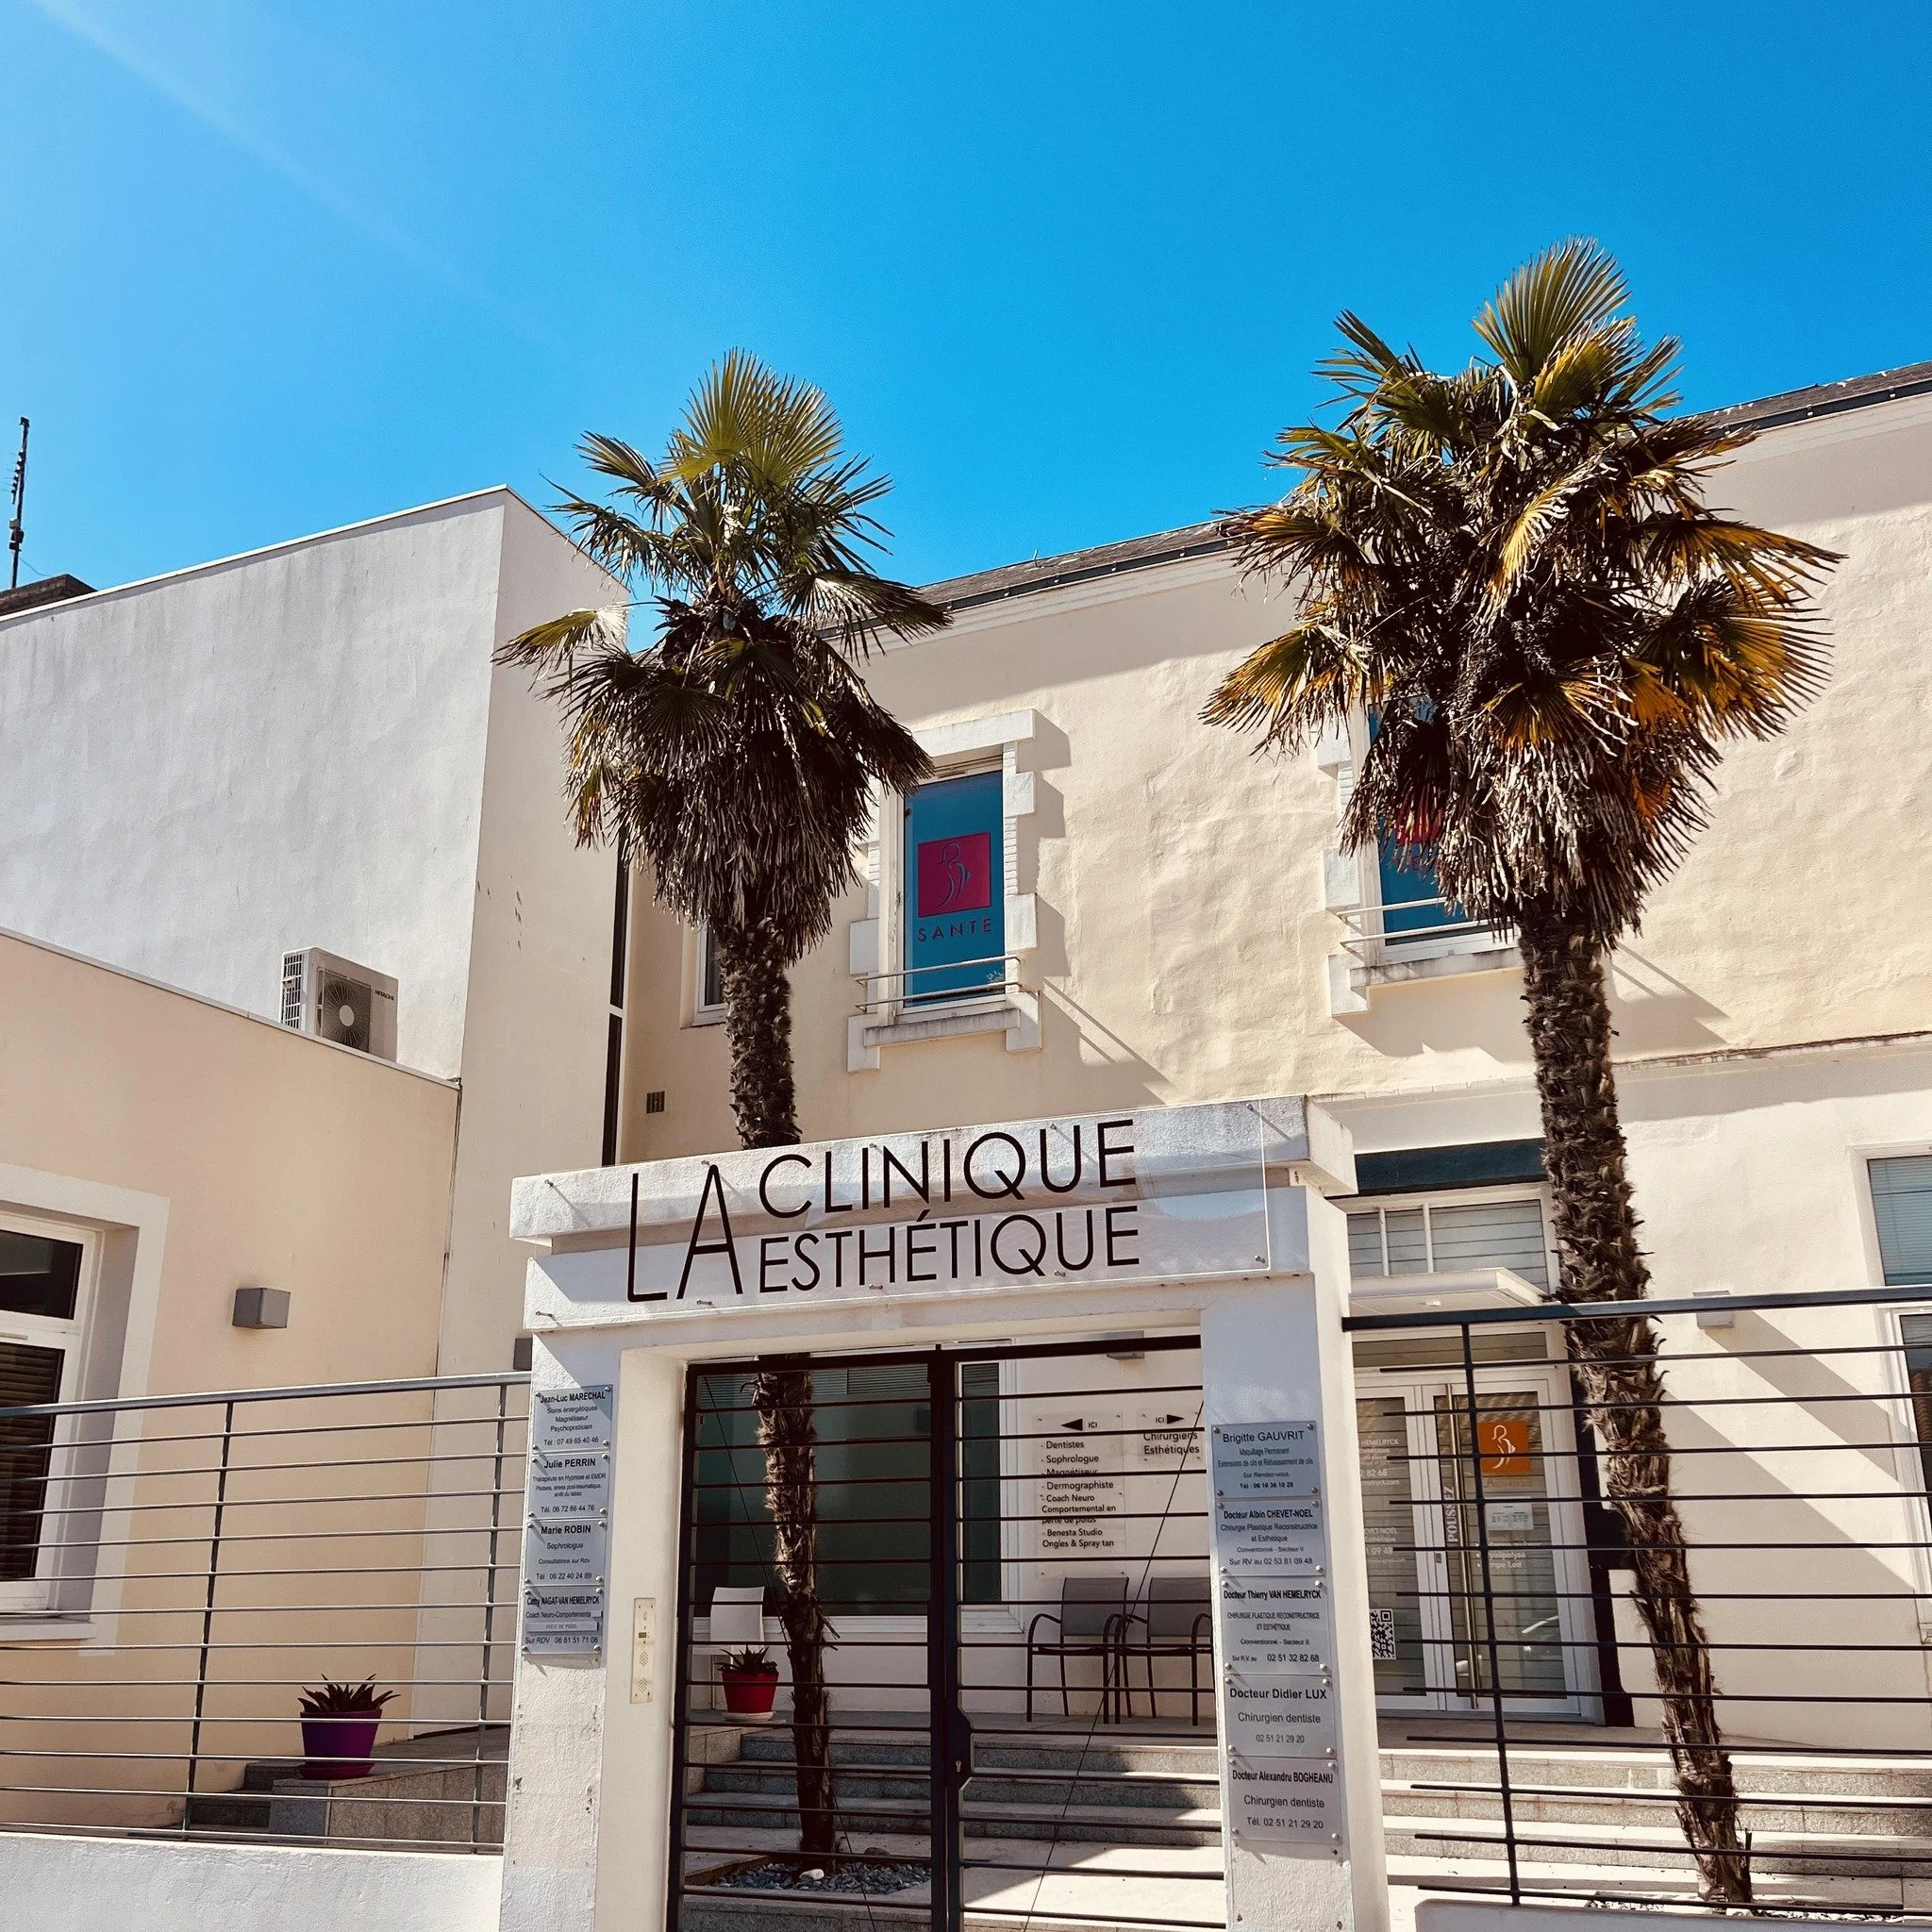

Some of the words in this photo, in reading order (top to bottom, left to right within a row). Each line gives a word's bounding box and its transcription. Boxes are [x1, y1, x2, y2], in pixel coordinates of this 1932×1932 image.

[626, 1164, 743, 1303] LA
[758, 1119, 1137, 1219] CLINIQUE
[758, 1205, 1140, 1293] ESTHÉTIQUE
[540, 1395, 568, 1403] Jean-Luc
[569, 1391, 605, 1401] MARECHAL
[1223, 1434, 1255, 1444] Brigitte
[1258, 1430, 1304, 1441] GAUVRIT
[1046, 1441, 1084, 1449] Dentistes
[1144, 1445, 1200, 1457] Esthétiques
[544, 1460, 562, 1468] Julie
[565, 1458, 595, 1467] PERRIN
[1046, 1455, 1099, 1464] Sophrologue
[1047, 1482, 1114, 1491] Dermographiste
[1042, 1505, 1104, 1514] Comportemental
[1224, 1510, 1248, 1519] Docteur
[1249, 1510, 1265, 1518] Albin
[1443, 1486, 1458, 1542] POUSSEZ
[541, 1526, 562, 1534] Marie
[565, 1525, 591, 1533] ROBIN
[1042, 1540, 1068, 1549] Ongles
[1079, 1540, 1099, 1549] Spray
[570, 1596, 600, 1604] HEMELRYCK
[1224, 1591, 1246, 1599] Docteur
[1248, 1590, 1267, 1601] Thierry
[1269, 1590, 1282, 1599] VAN
[1283, 1590, 1321, 1599] HEMELRYCK
[1230, 1688, 1269, 1698] Docteur
[1273, 1689, 1302, 1698] Didier
[1306, 1689, 1327, 1699] LUX
[1238, 1711, 1283, 1724] Chirurgien
[1286, 1713, 1321, 1723] dentiste
[1232, 1770, 1257, 1780] Docteur
[1258, 1771, 1292, 1783] Alexandru
[1293, 1772, 1333, 1783] BOGHEANU
[1243, 1794, 1288, 1807] Chirurgien
[1291, 1796, 1325, 1808] dentiste
[1247, 1817, 1261, 1826] Tél.
[1313, 1820, 1323, 1829] 20
